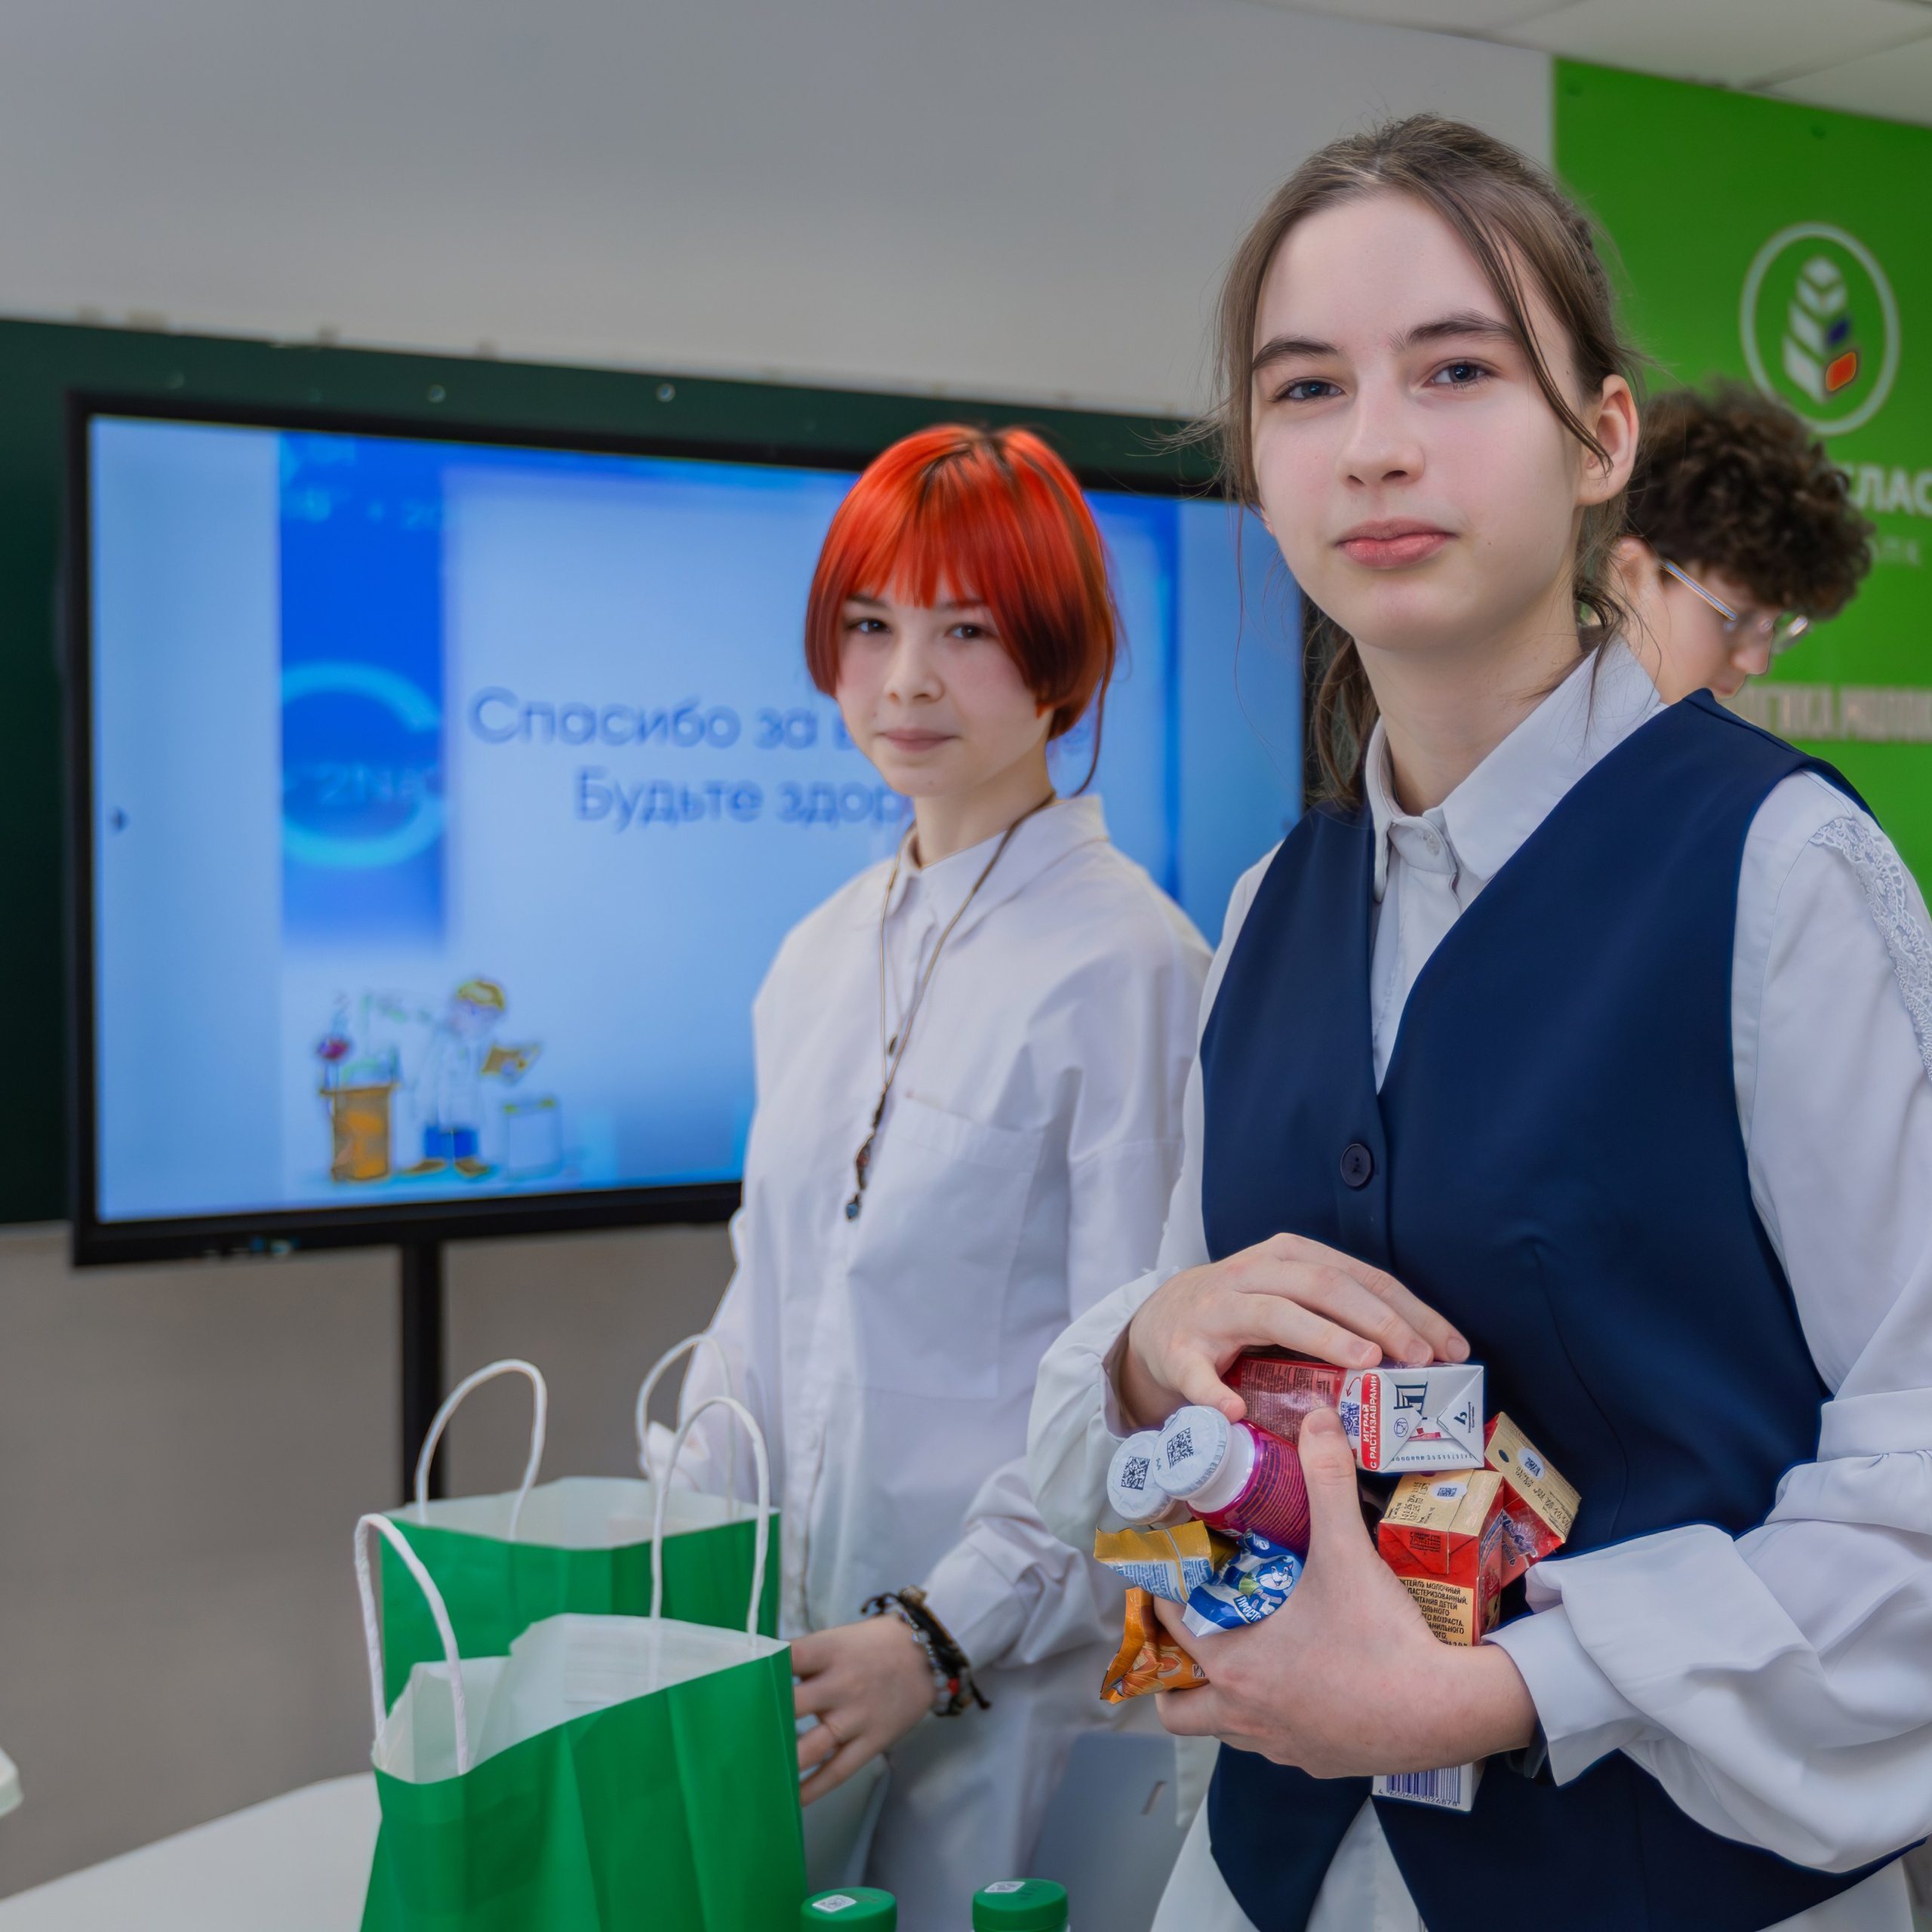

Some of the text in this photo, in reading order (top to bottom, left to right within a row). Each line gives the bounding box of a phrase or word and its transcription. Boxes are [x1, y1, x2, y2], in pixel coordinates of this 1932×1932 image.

[1844, 462, 1932, 516] ЛАС
[467, 686, 743, 749] Спасибо
[755, 706, 819, 749] за
[574, 766, 762, 833] Будьте
[1369, 1375, 1378, 1457] РАСТИЗАВРАМИ
[1439, 1601, 1458, 1611] ДЕТЕЙ
